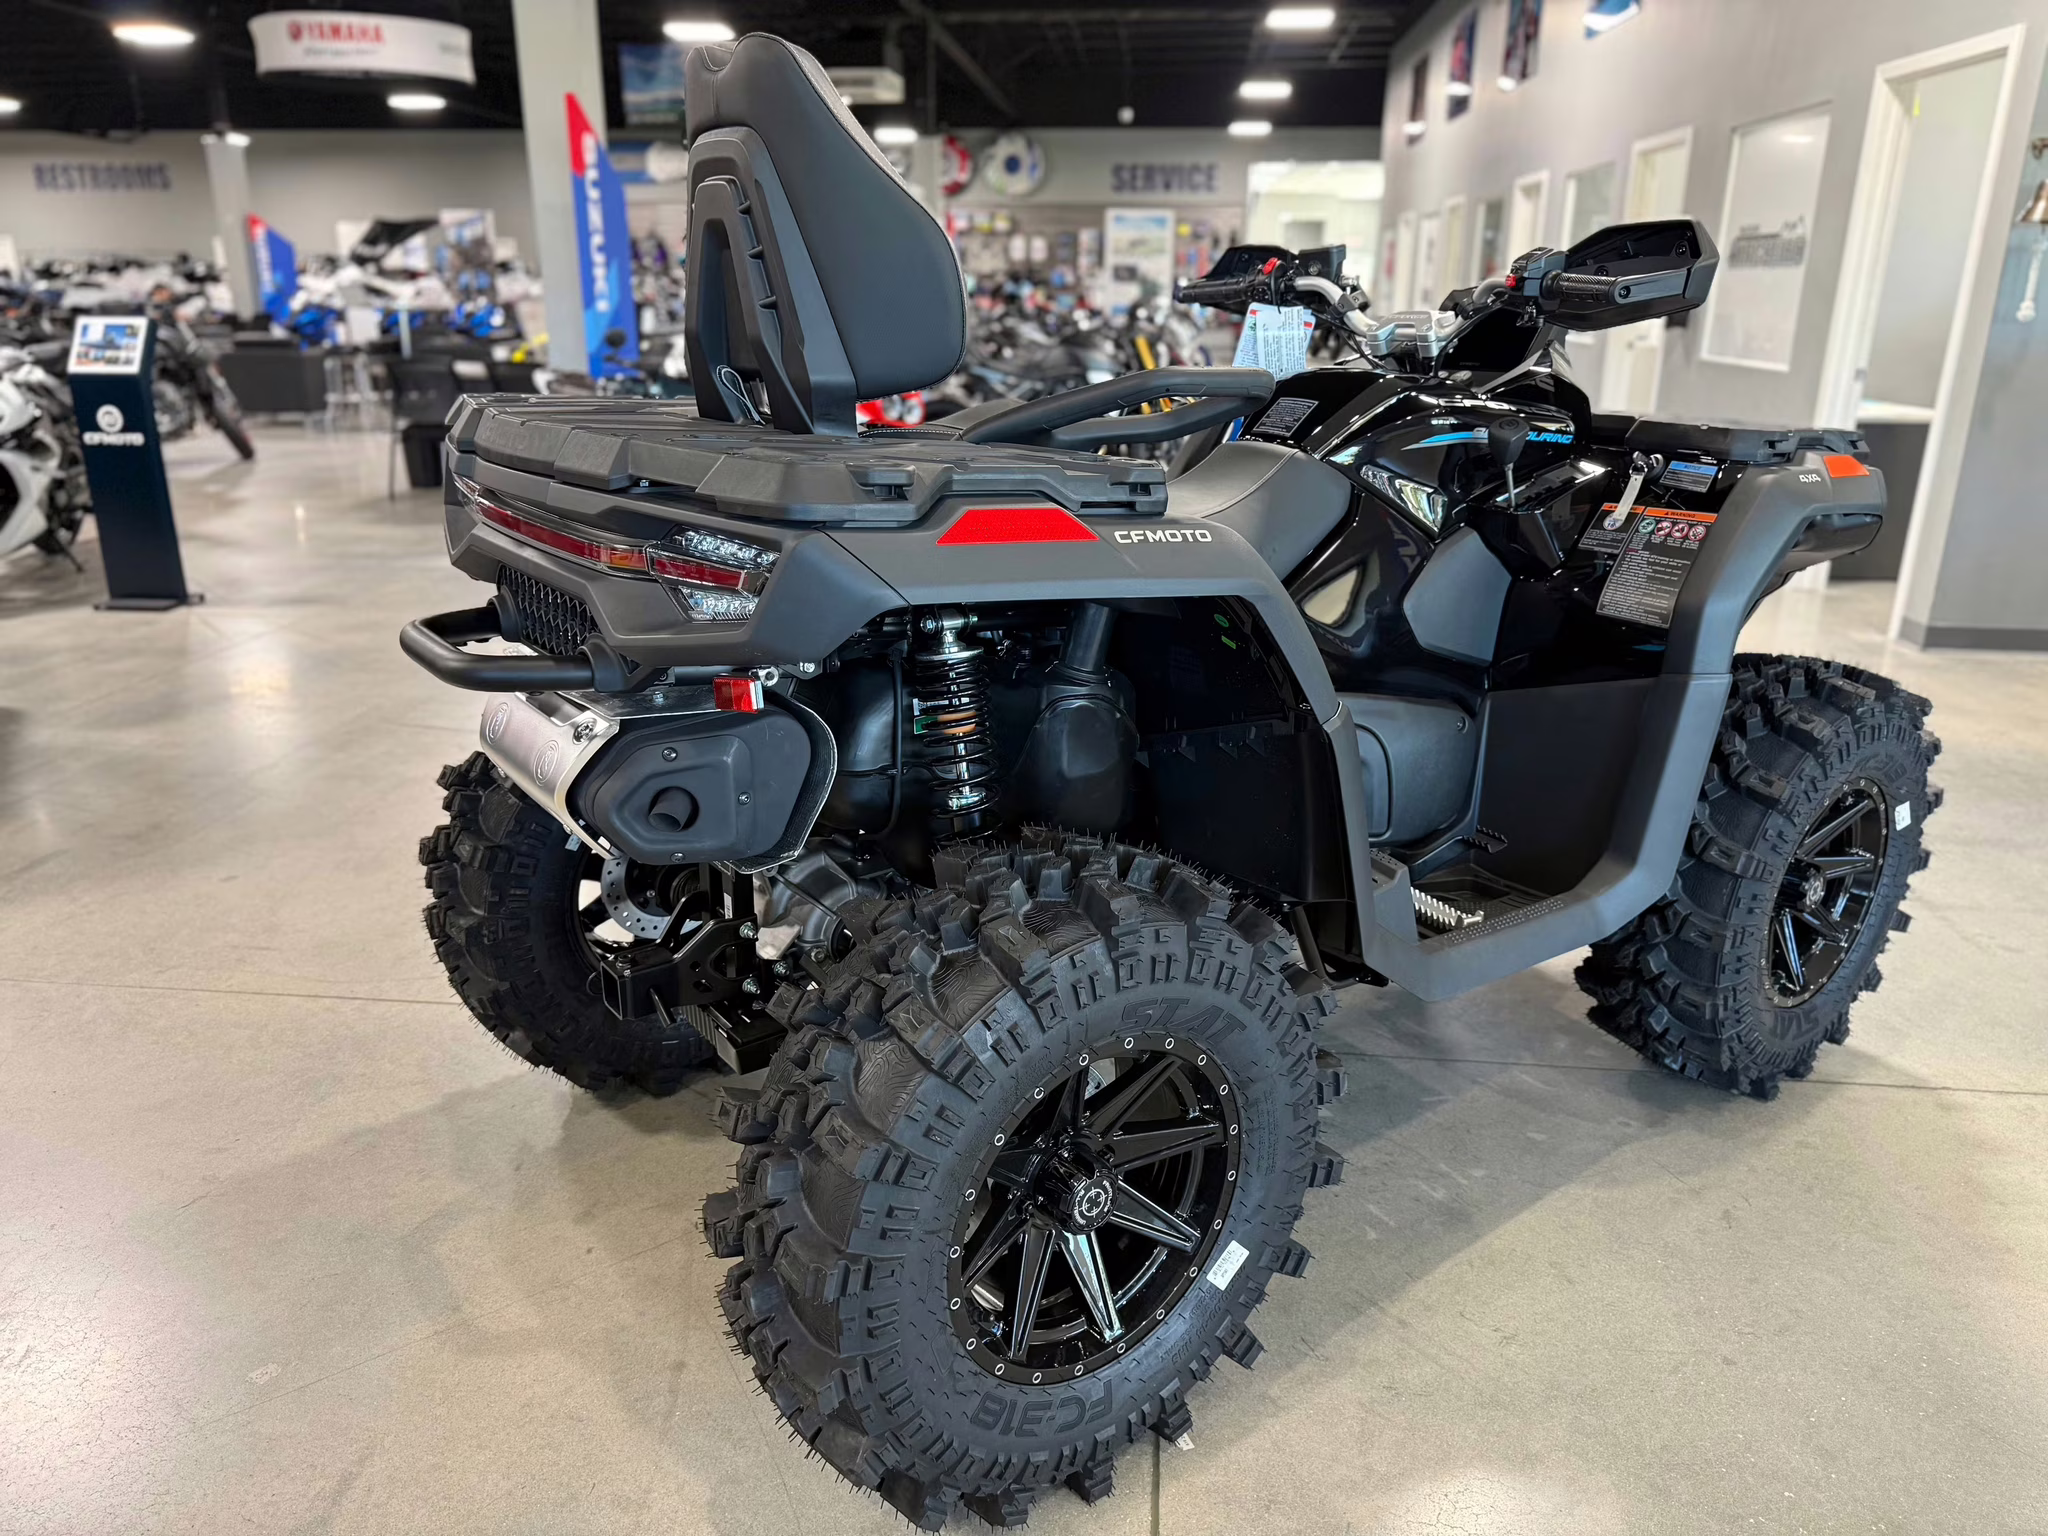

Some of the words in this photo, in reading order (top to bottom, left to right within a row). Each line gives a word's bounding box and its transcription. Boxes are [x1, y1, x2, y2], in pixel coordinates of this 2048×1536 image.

[308, 22, 385, 43] YAMAHA
[34, 162, 173, 192] RESTROOMS
[1111, 164, 1217, 192] SERVICE
[580, 131, 611, 313] SUZUKI
[1114, 529, 1213, 544] CFMOTO
